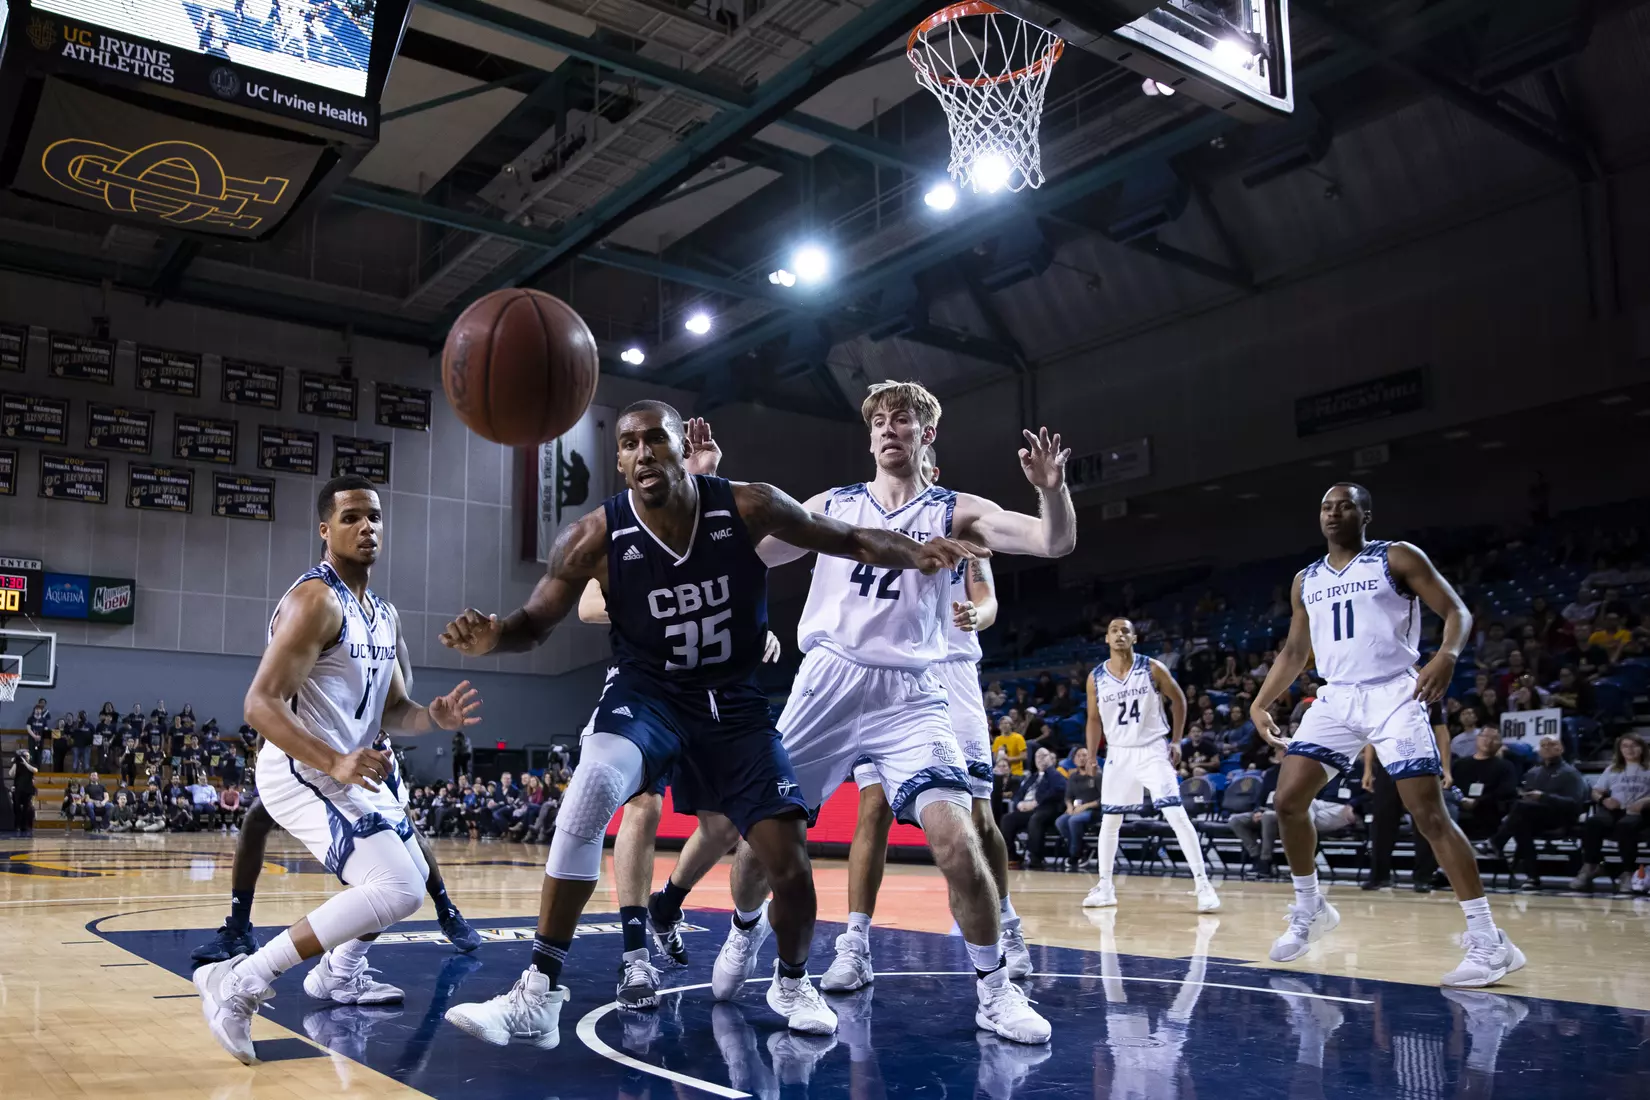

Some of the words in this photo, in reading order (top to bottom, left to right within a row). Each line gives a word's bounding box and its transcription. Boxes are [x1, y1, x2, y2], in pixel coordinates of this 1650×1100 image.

[64, 24, 93, 47] UC
[99, 34, 172, 68] IRVINE
[61, 41, 175, 84] ATHLETICS
[246, 81, 270, 101] UC
[273, 88, 316, 113] Irvine
[319, 100, 368, 127] Health
[710, 527, 733, 541] WAC
[623, 552, 644, 561] adidas
[45, 585, 85, 603] AQUAFINA
[648, 575, 730, 619] CBU
[850, 563, 902, 600] 42
[1307, 591, 1322, 605] UC
[1327, 580, 1379, 599] IRVINE
[1331, 599, 1354, 641] 11
[665, 608, 732, 671] 35
[1102, 695, 1117, 703] UC
[1117, 686, 1148, 700] IRVINE
[1118, 699, 1140, 725] 24
[1503, 718, 1526, 740] Rip
